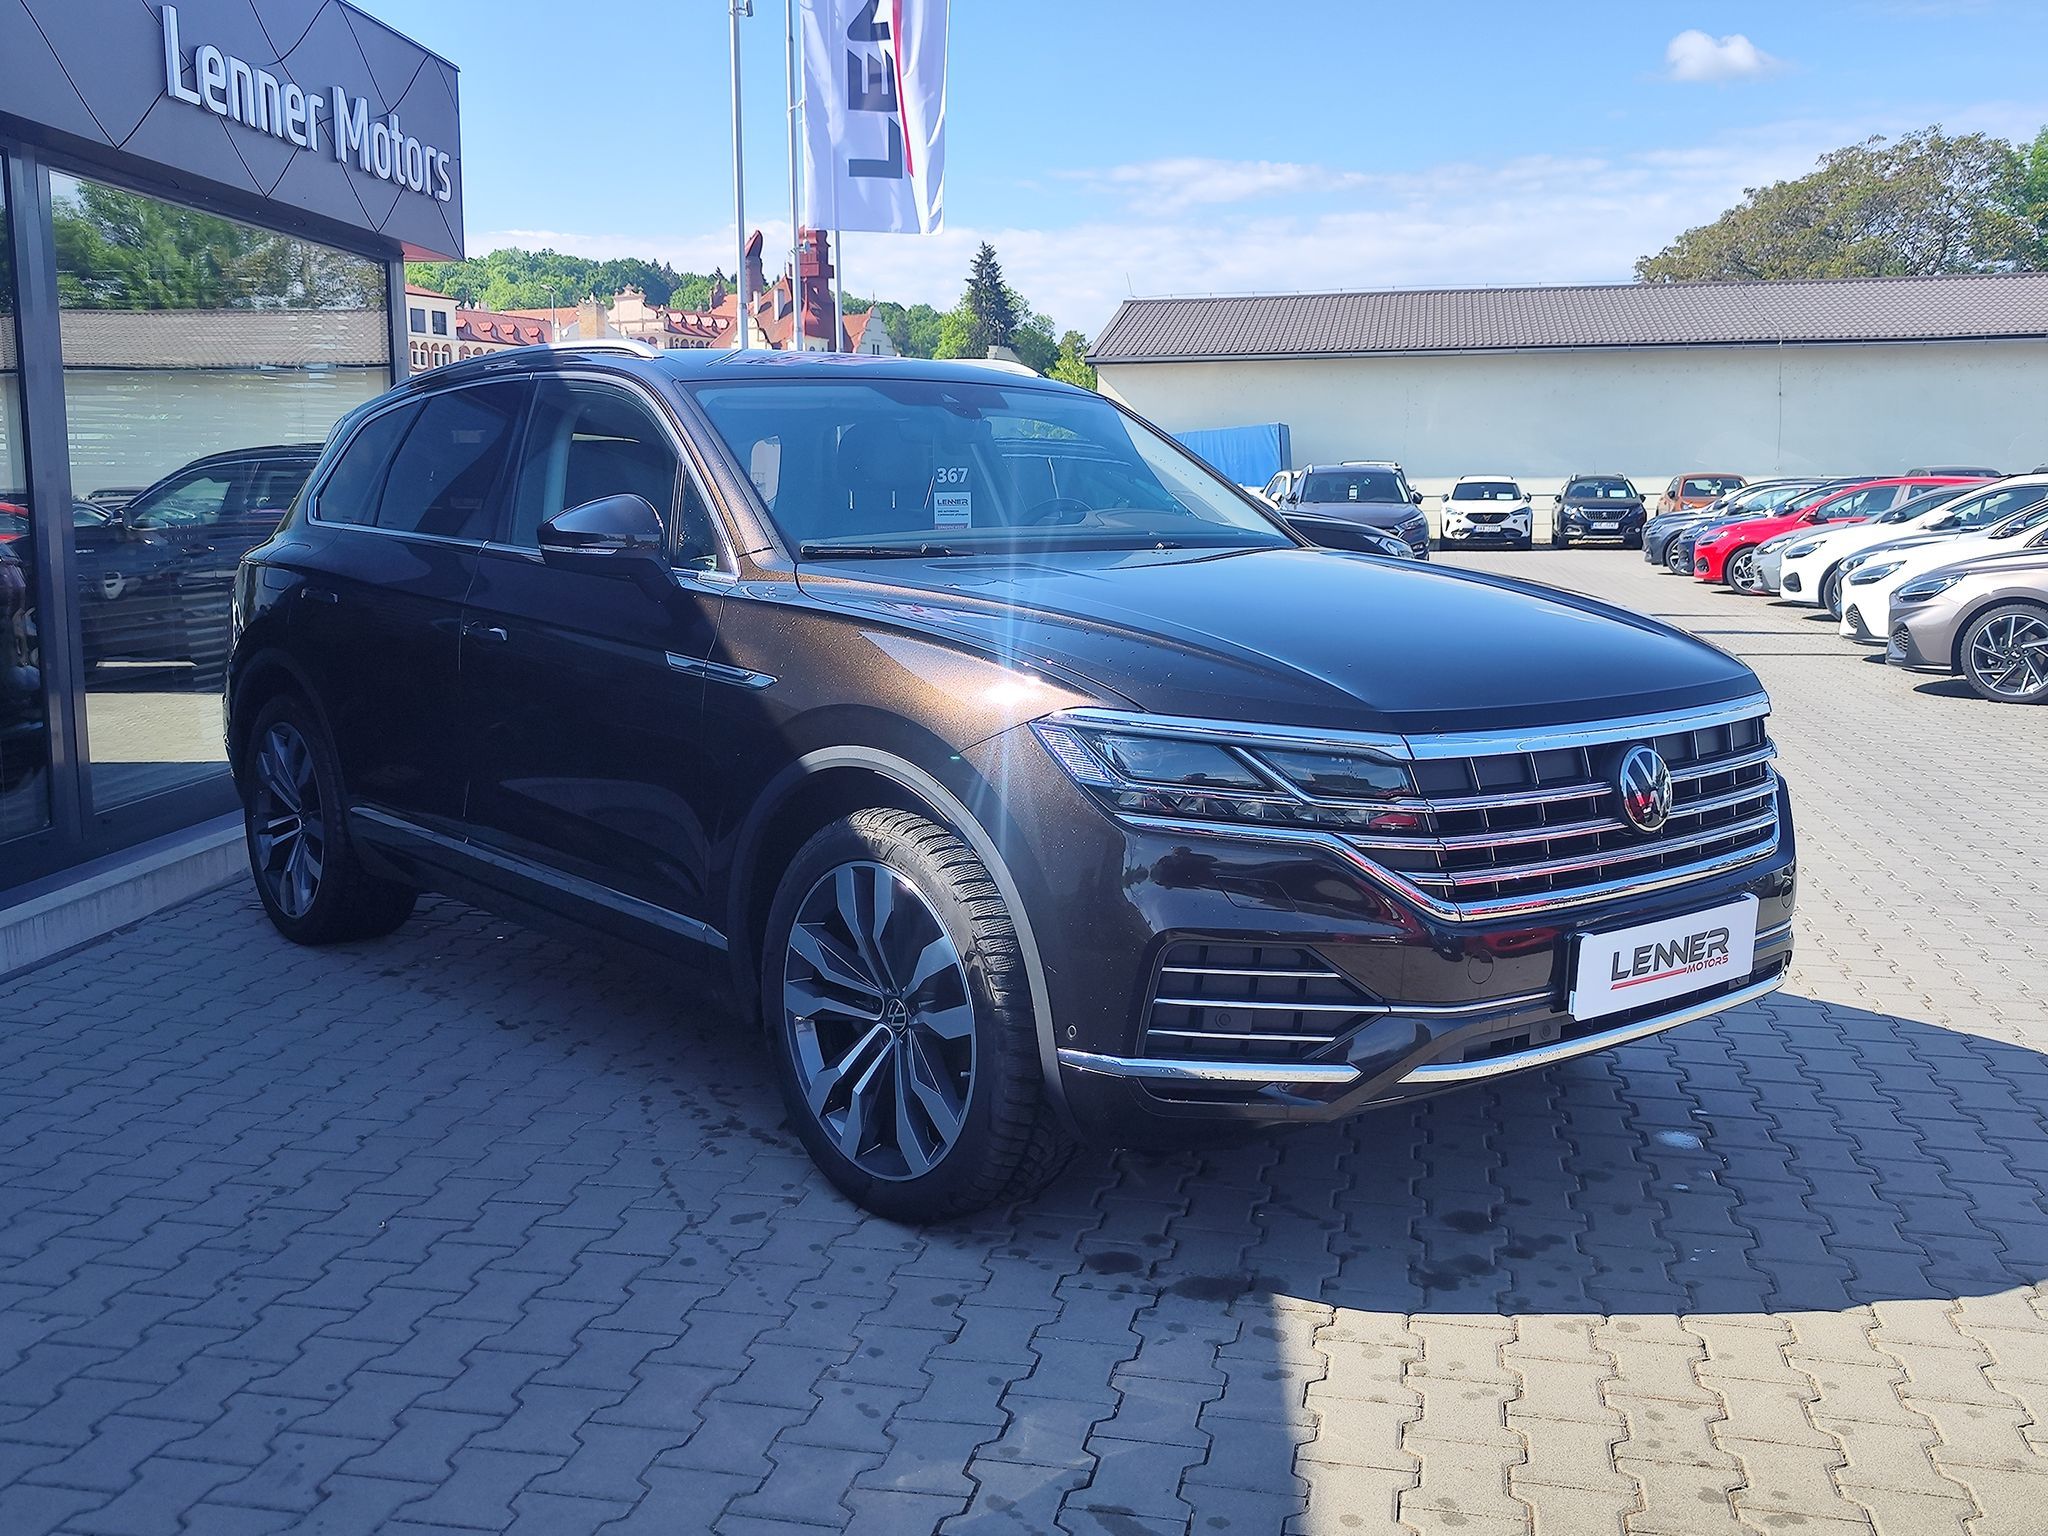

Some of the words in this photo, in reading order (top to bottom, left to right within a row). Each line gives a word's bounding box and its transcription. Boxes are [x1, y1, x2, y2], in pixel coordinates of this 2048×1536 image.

[161, 5, 324, 152] Lenner
[331, 86, 451, 202] Motors
[936, 467, 969, 484] 367
[1611, 926, 1730, 982] LENNER
[1686, 954, 1729, 974] MOTORS
